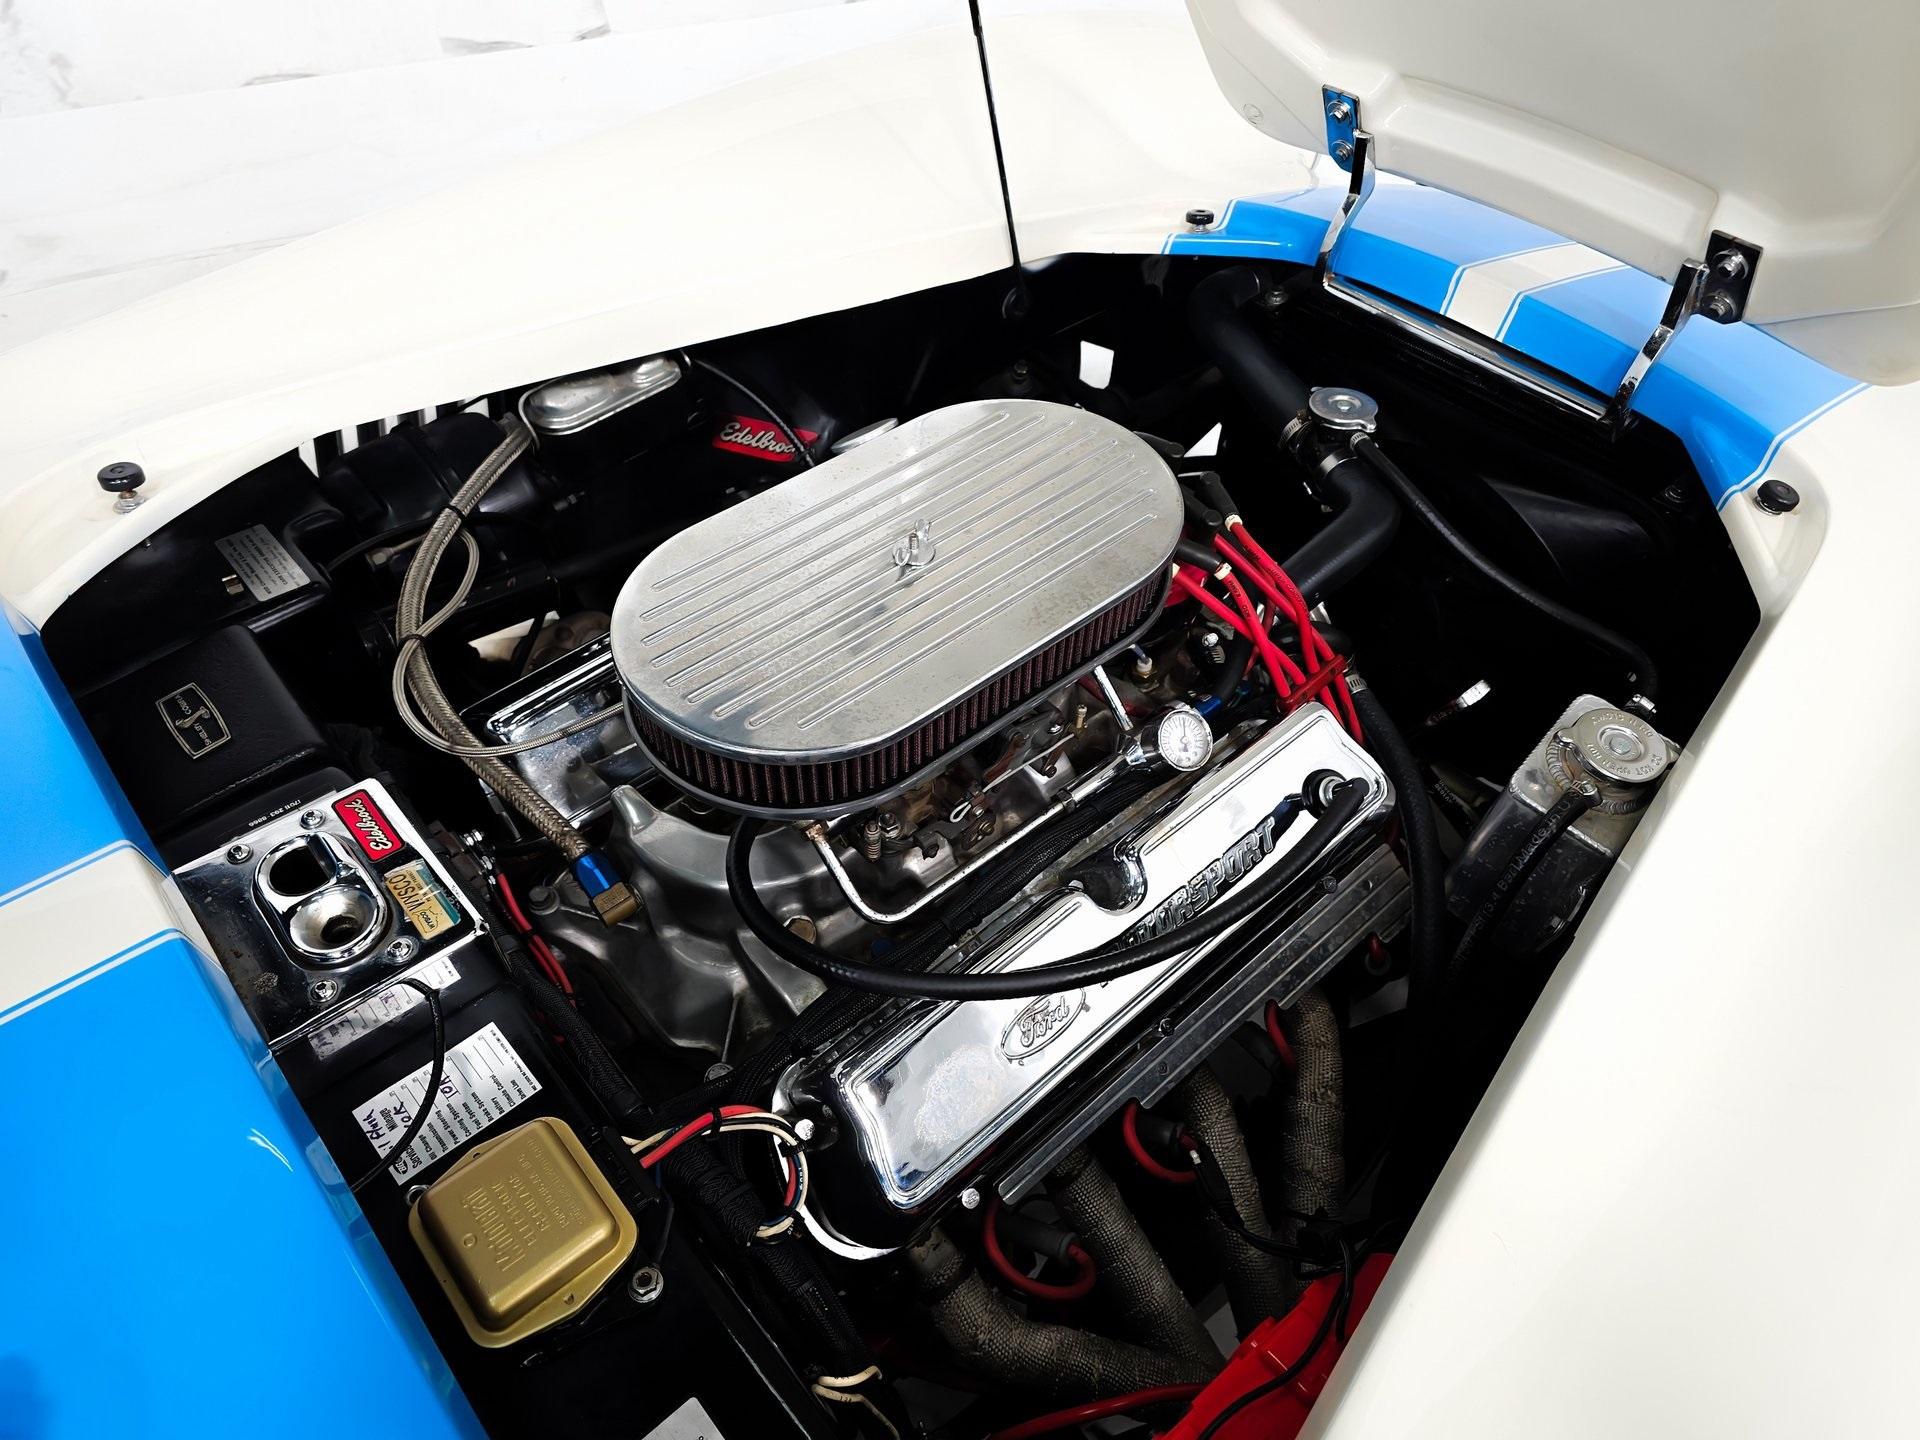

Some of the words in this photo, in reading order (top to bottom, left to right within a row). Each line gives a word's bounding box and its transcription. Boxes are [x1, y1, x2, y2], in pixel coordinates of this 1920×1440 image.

[720, 422, 799, 453] Edelbroc
[173, 693, 192, 716] COBRA
[192, 721, 212, 746] SHELBY
[349, 797, 393, 852] Edelbrock
[387, 870, 426, 912] WYSCO
[418, 910, 435, 929] WYSCO
[1011, 993, 1073, 1049] Ford
[488, 1072, 503, 1090] Control
[508, 1078, 519, 1089] Line
[469, 1090, 486, 1109] System
[498, 1087, 516, 1107] Climate
[514, 1086, 526, 1100] Drive
[444, 1101, 461, 1121] System
[460, 1100, 476, 1118] System
[480, 1107, 493, 1122] Brake
[489, 1095, 504, 1115] Battery
[377, 1105, 399, 1131] Mileage
[432, 1108, 450, 1130] Steering
[455, 1117, 472, 1137] Cooling
[469, 1115, 483, 1130] Fuel
[416, 1133, 433, 1154] Change
[425, 1121, 449, 1152] Transmission
[445, 1127, 460, 1145] Power
[426, 1150, 438, 1160] Oil
